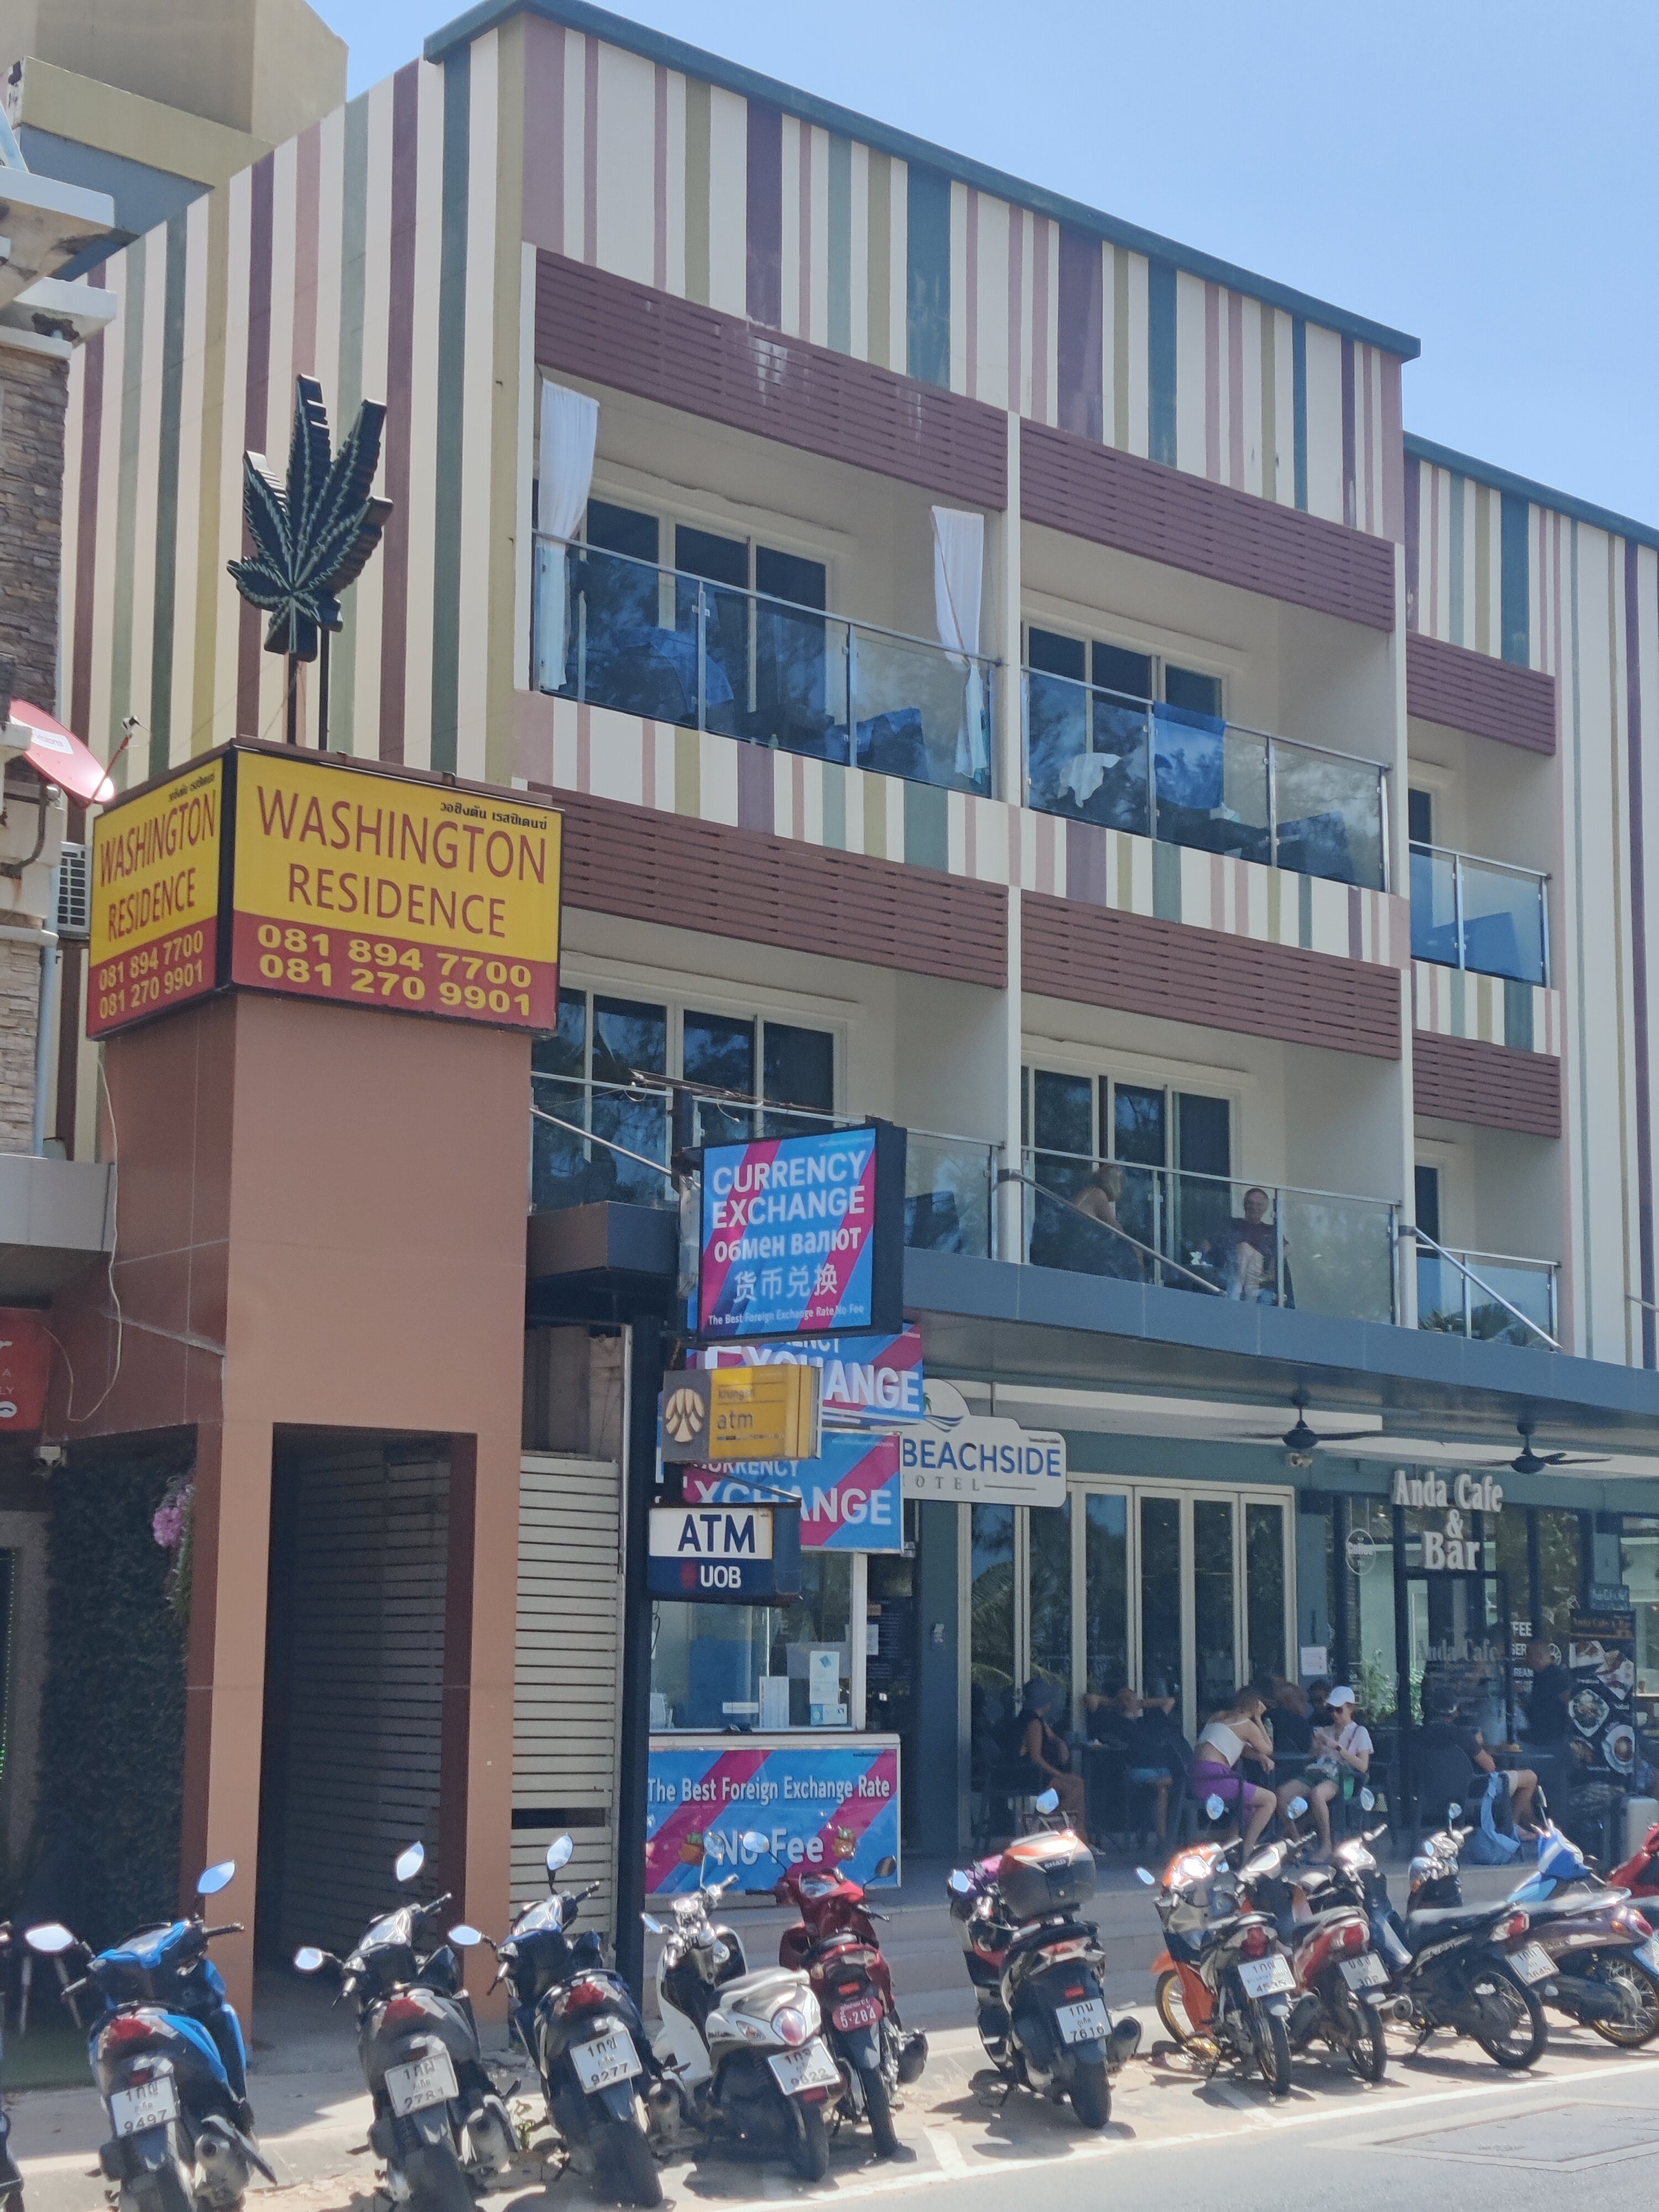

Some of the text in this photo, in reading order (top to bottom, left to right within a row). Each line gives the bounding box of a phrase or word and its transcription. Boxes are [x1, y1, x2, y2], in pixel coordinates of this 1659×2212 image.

[100, 790, 216, 887] WASHINGTON
[257, 785, 546, 885] WASHINGTON
[108, 867, 196, 942] RESIDENCE
[289, 863, 505, 938] RESIDENCE
[99, 930, 204, 992] 081 894 7700
[258, 924, 531, 988] 081 894 7700
[99, 959, 203, 1020] 081 270 9901
[259, 954, 530, 1016] 081 270 9901
[713, 1150, 867, 1196] CURRENCY
[712, 1186, 866, 1230] EXCHANGE
[791, 1227, 862, 1255] валют
[733, 1262, 838, 1304] 货币兑换
[708, 1315, 723, 1326] The
[725, 1314, 743, 1324] Best
[745, 1311, 774, 1323] Foreign
[776, 1308, 814, 1321] Exchange
[816, 1306, 834, 1317] Rate
[849, 1304, 864, 1313] Fee
[717, 1411, 753, 1430] atm
[902, 1438, 1062, 1477] BEACHSIDE
[684, 1475, 891, 1525] XCANGE
[1393, 1470, 1503, 1512] Anda Cafe
[677, 1514, 756, 1554] ATM
[1446, 1509, 1464, 1540] &
[1424, 1531, 1480, 1571] Bar
[701, 1566, 742, 1588] UOB
[648, 1775, 890, 1806] The Best Foreign Exchange Rate
[771, 1828, 825, 1864] Fee
[591, 2062, 628, 2085] 9277
[124, 2108, 167, 2134] 9497
